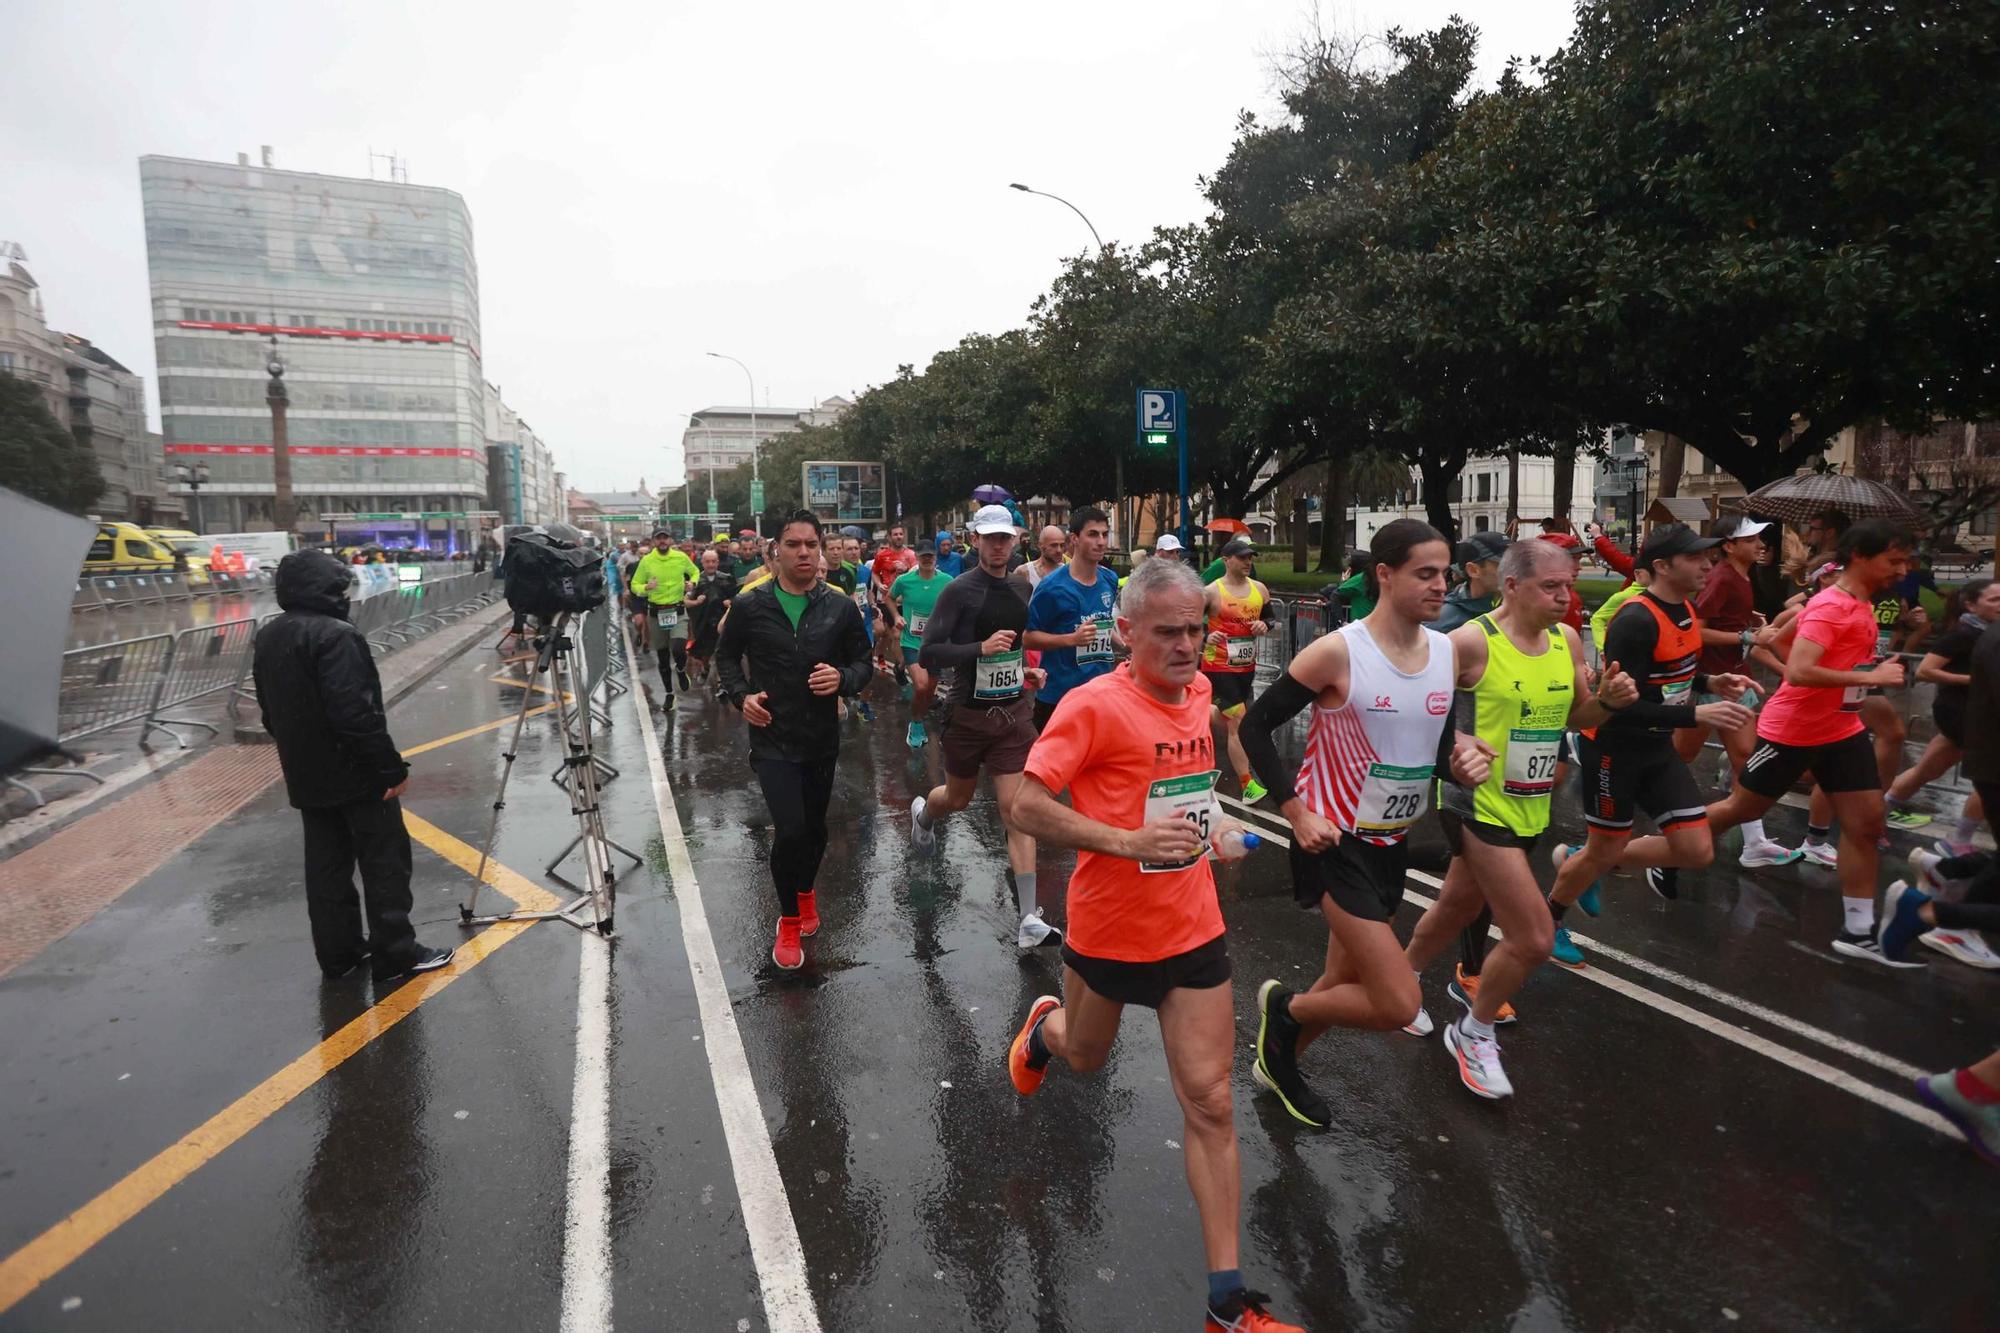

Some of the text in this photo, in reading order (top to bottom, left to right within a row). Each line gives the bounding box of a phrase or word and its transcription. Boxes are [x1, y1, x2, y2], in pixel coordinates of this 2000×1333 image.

[1237, 647, 1253, 660] 498
[988, 668, 1018, 688] 1654
[1527, 755, 1556, 779] 872
[1383, 793, 1420, 820] 228
